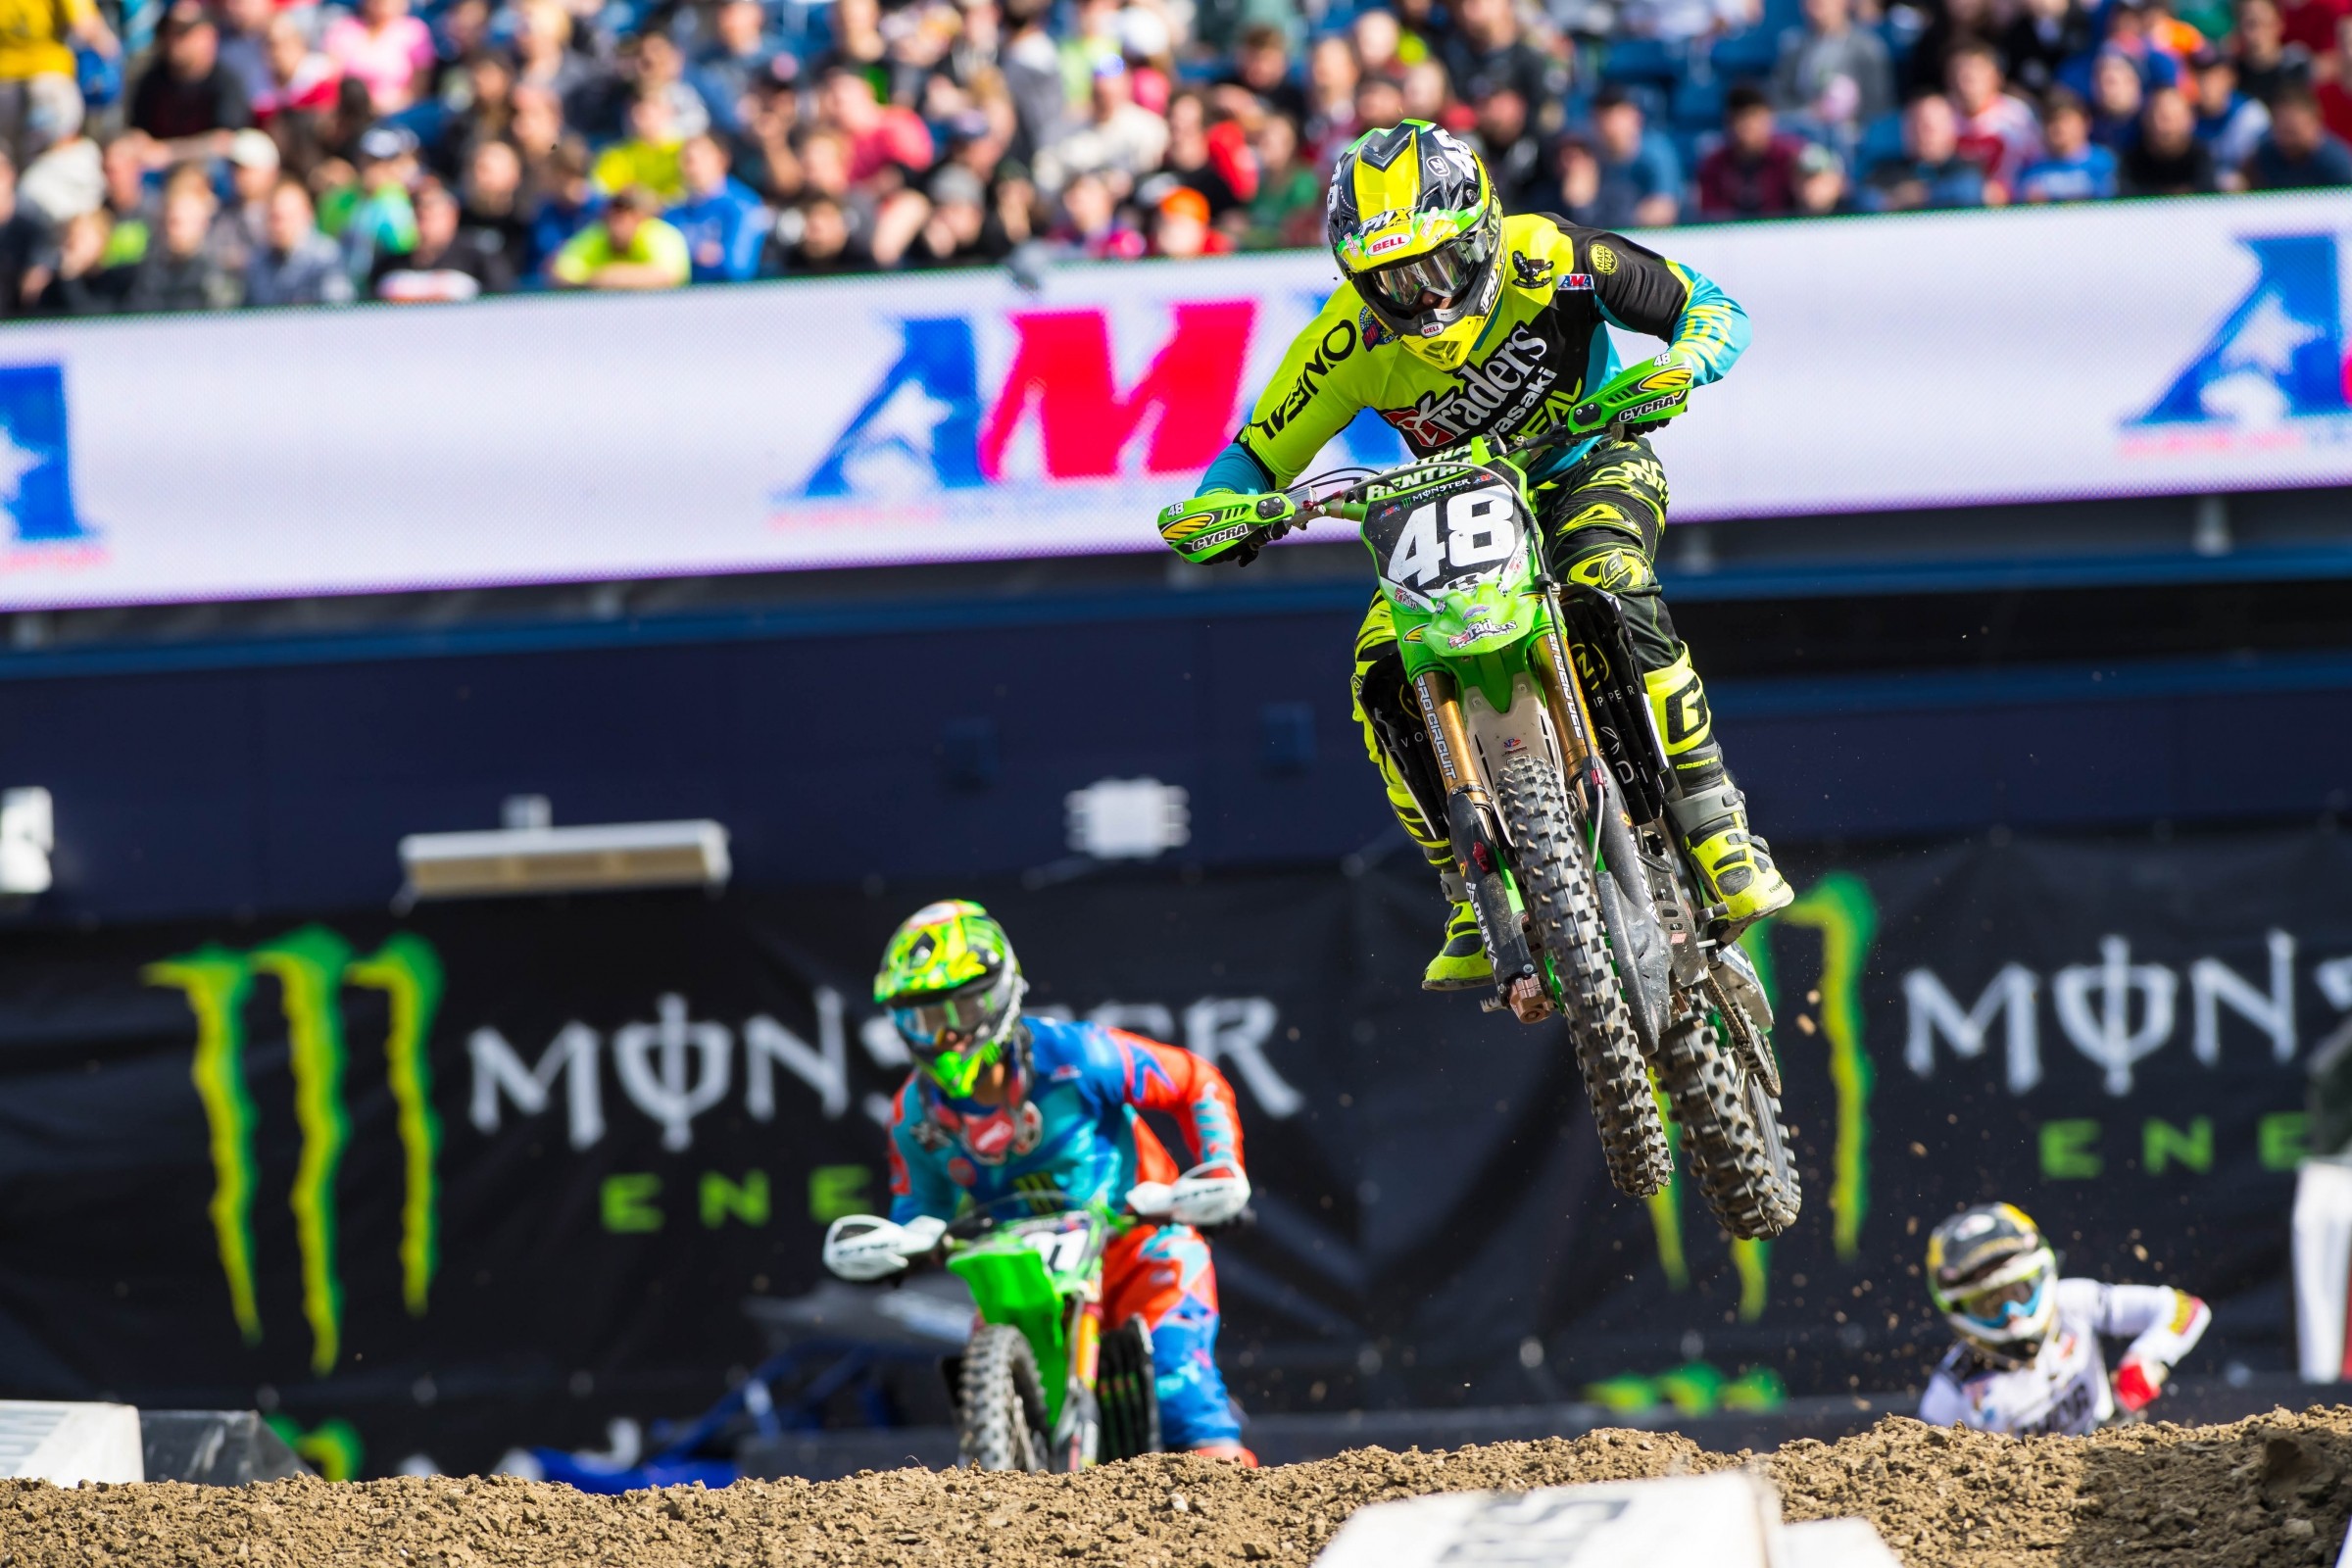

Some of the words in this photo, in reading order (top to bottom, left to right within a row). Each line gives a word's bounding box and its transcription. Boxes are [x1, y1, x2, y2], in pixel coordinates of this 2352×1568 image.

[1373, 237, 1405, 253] BELL
[1596, 246, 1605, 269] HARD
[1558, 274, 1592, 288] AMA
[1424, 325, 1441, 334] BELL
[1652, 352, 1672, 368] 48
[1619, 395, 1676, 422] CYCRA
[1412, 478, 1471, 502] MONSTER
[1167, 502, 1185, 518] 48
[1192, 523, 1249, 552] CYCRA
[1388, 484, 1516, 586] 48
[1417, 674, 1435, 711] PRO
[1427, 711, 1457, 779] CIRCUIT
[1473, 902, 1498, 970] DUBYA
